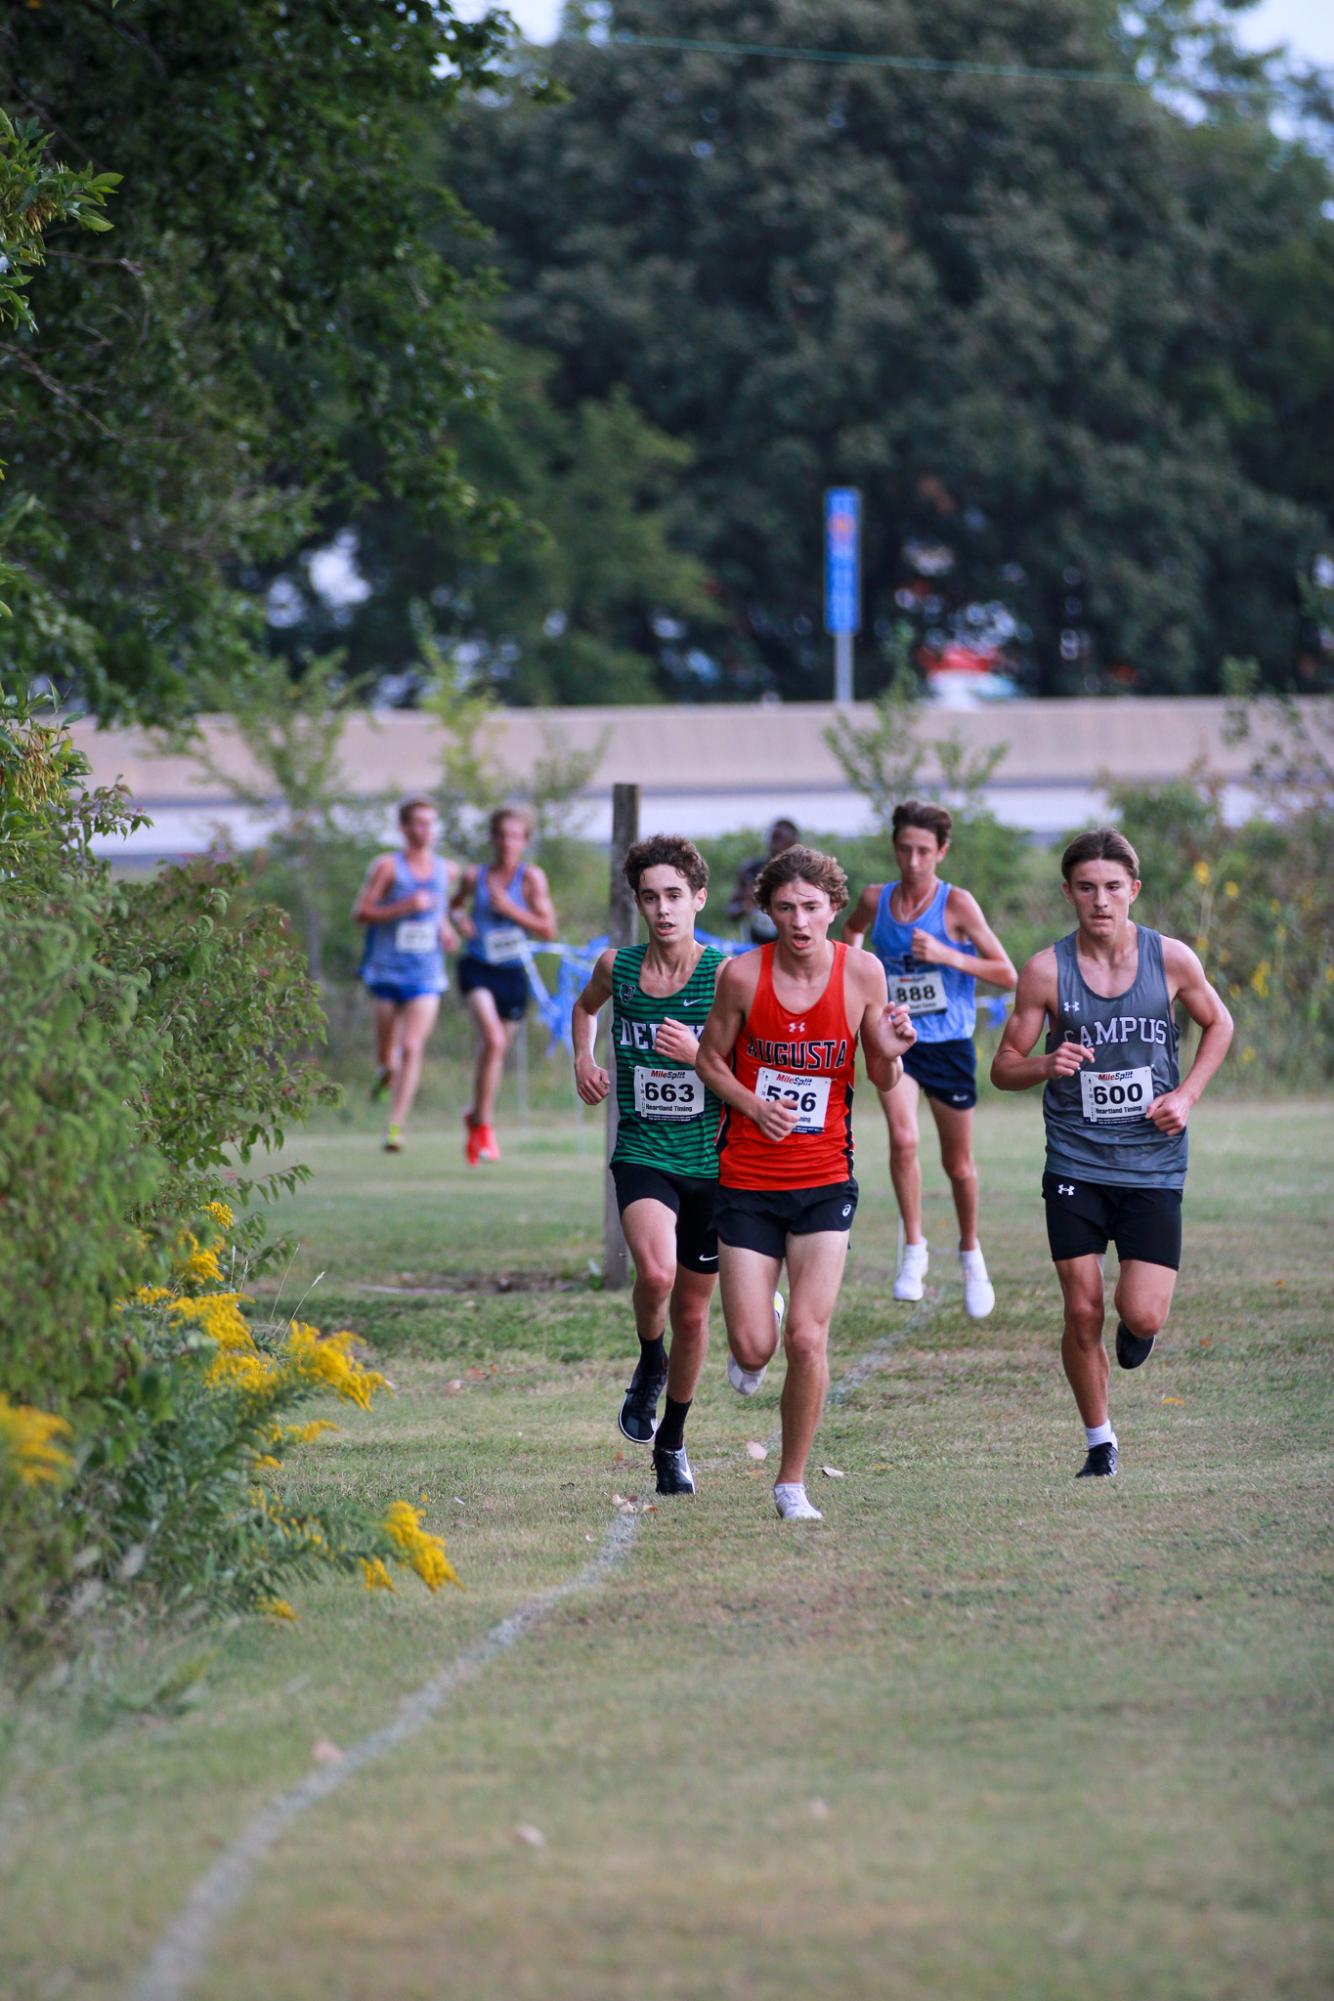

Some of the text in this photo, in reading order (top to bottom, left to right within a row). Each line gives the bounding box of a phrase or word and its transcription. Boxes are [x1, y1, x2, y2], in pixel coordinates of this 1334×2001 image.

[897, 985, 935, 1002] 888
[747, 1035, 847, 1070] AUGUSTA
[651, 1070, 686, 1080] MileSplit
[1098, 1071, 1133, 1081] MileSplit
[645, 1082, 695, 1102] 663
[766, 1085, 817, 1112] 526
[1094, 1083, 1143, 1105] 600
